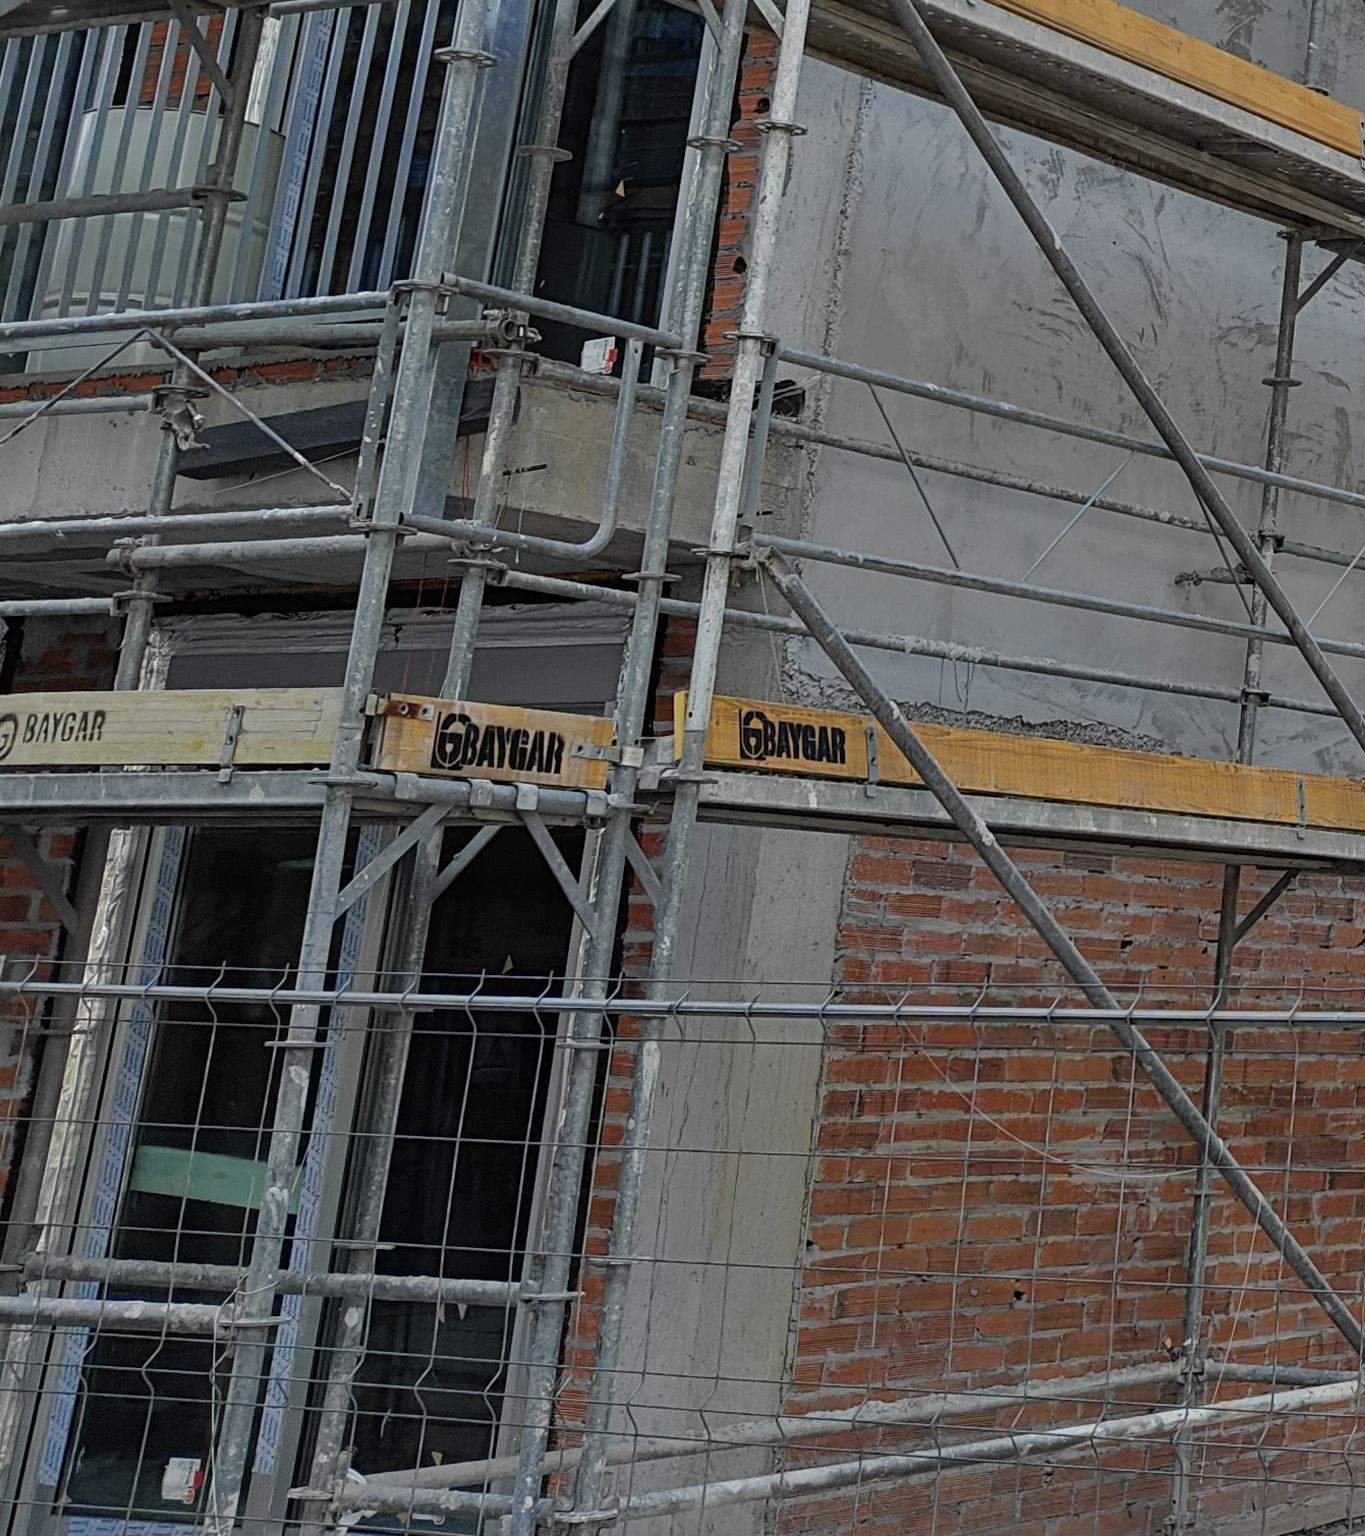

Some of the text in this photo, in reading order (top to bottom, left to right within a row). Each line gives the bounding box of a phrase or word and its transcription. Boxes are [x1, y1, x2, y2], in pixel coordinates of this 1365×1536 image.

[22, 710, 107, 743] BAYGAR
[462, 722, 566, 775] BAYGAR
[763, 720, 847, 764] BAYGAR
